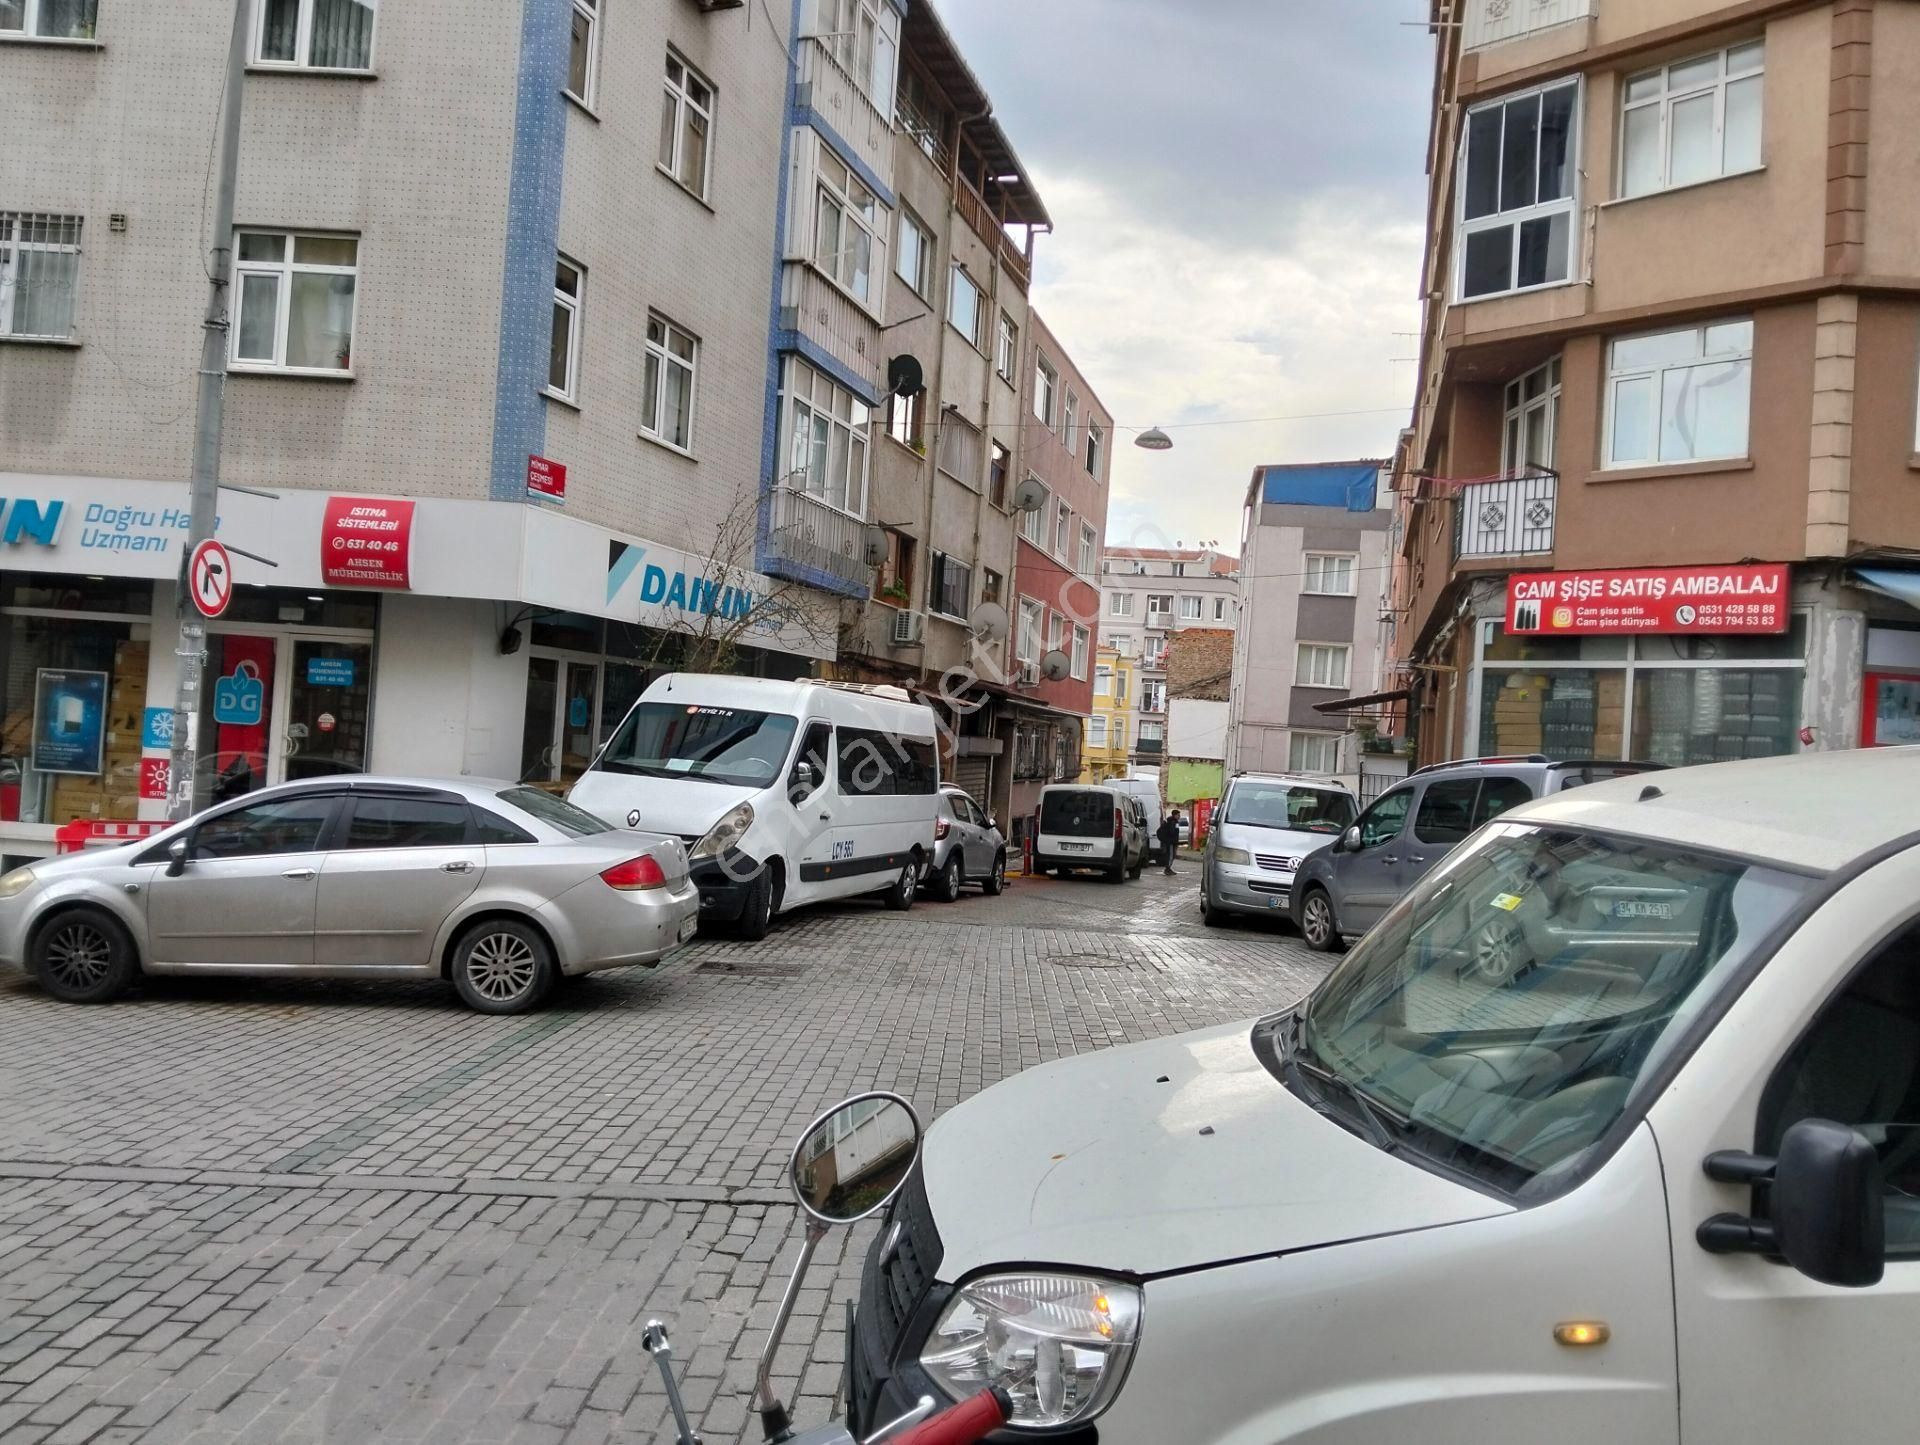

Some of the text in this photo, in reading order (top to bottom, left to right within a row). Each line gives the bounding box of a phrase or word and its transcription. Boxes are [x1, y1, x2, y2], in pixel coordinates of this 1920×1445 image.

[84, 504, 221, 531] Doğru Ha
[351, 507, 386, 517] ISITMA
[337, 516, 399, 530] SİSTEMLERİ
[80, 528, 168, 551] Uzmanı
[347, 538, 399, 551] 631 40 46
[347, 558, 384, 568] AHSEN
[328, 568, 404, 581] MÜHENDİSLİK
[640, 563, 752, 621] DAIKIN
[1514, 575, 1778, 601] CAM ŞİŞE SATIŞ AMBALAJ
[1576, 606, 1597, 615] Cam
[1699, 604, 1775, 614] 0531 428 58 88
[1576, 617, 1597, 626] Cam
[1699, 616, 1774, 625] 0543 794 53 83
